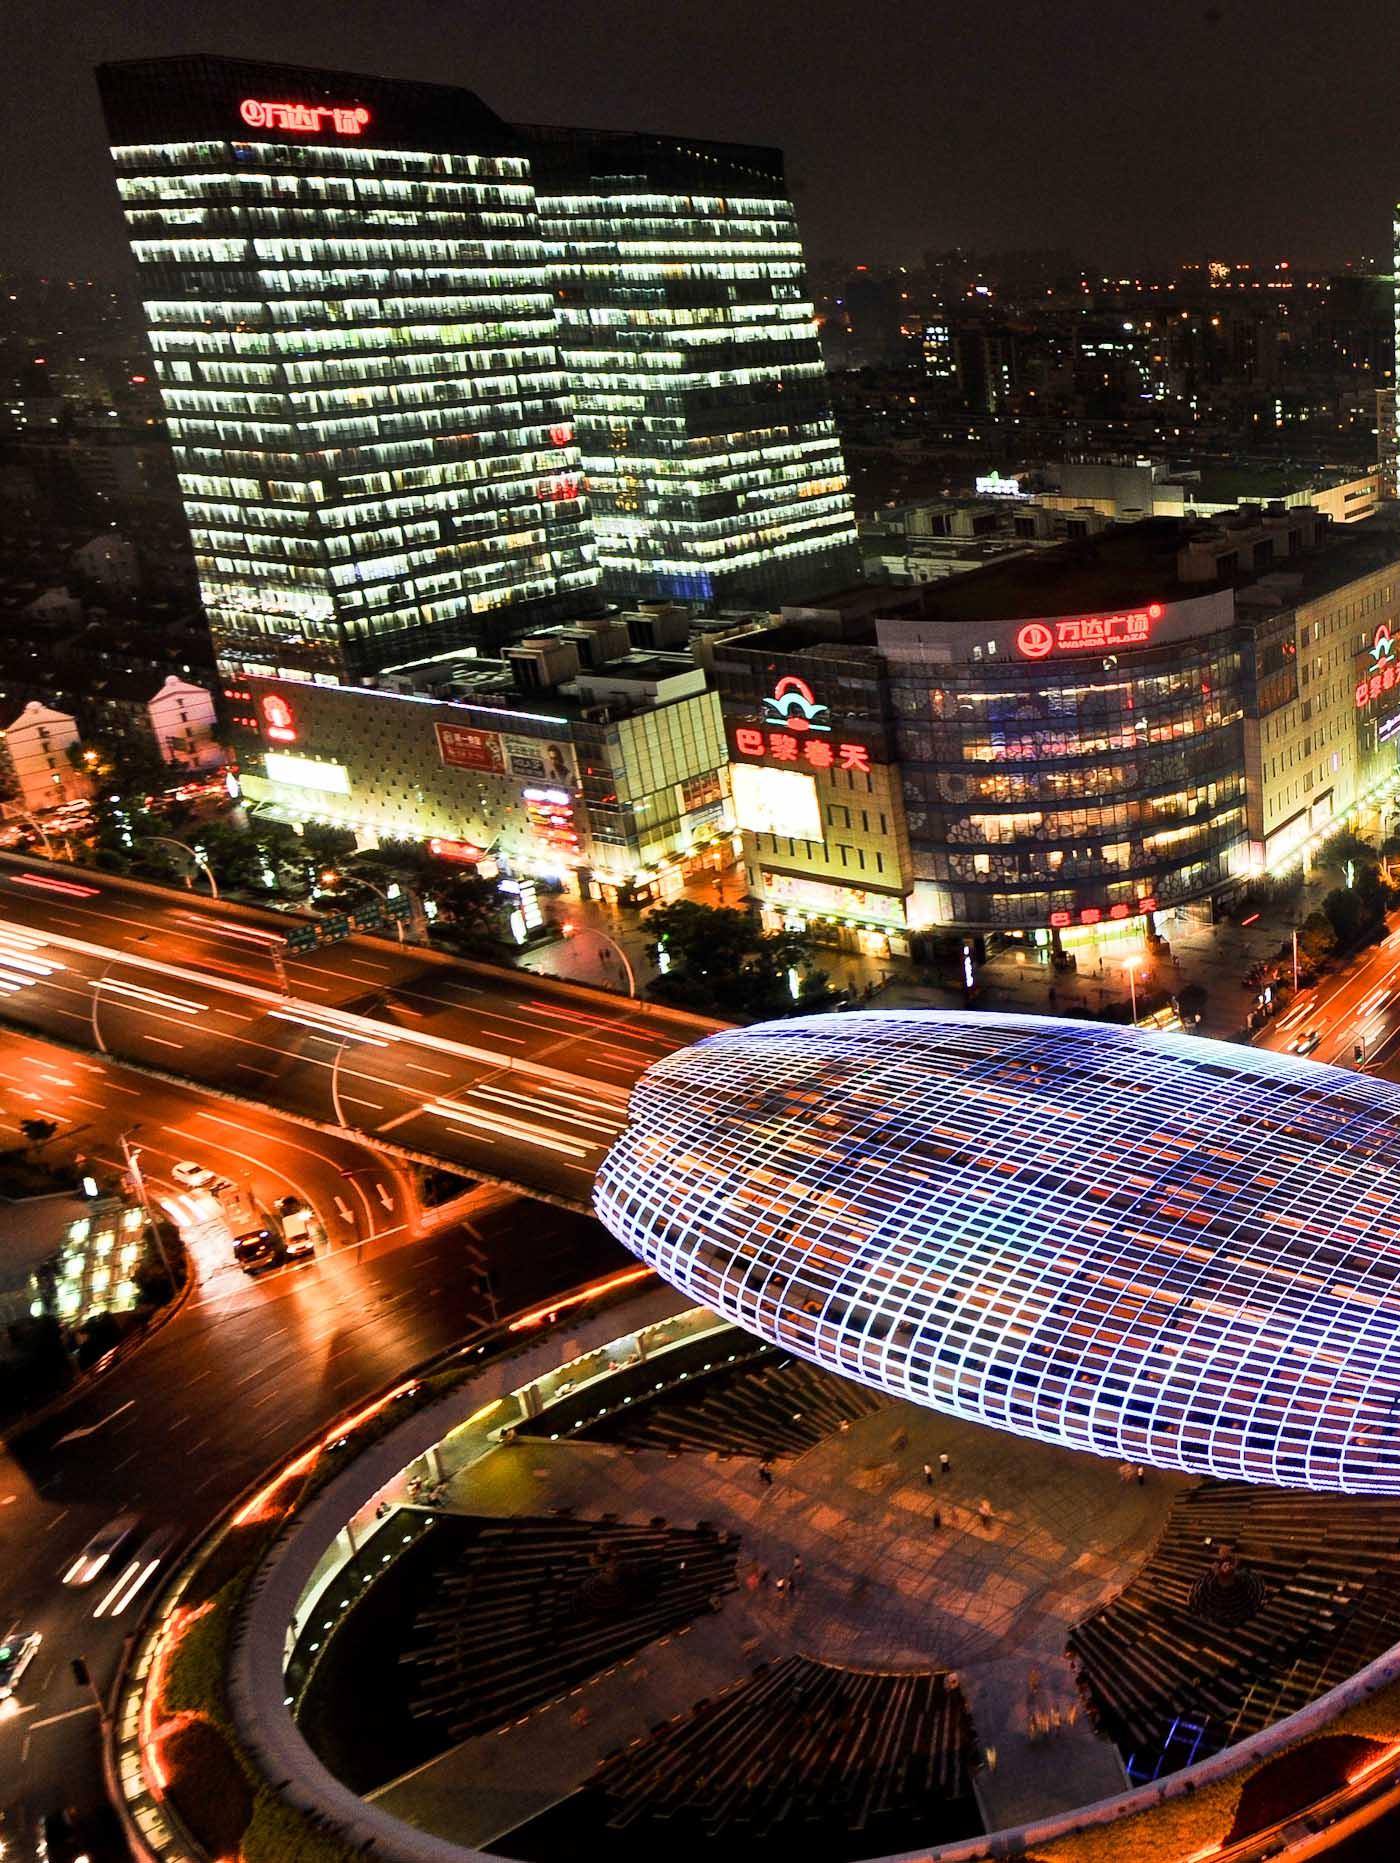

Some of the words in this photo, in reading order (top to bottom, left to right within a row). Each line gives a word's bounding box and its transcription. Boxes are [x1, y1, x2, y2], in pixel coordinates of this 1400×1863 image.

[261, 103, 361, 134] 万达广场
[1056, 613, 1149, 641] 万达广场
[1057, 638, 1106, 649] WANDA
[1107, 632, 1149, 645] PLAZA
[736, 728, 871, 773] 巴黎春天
